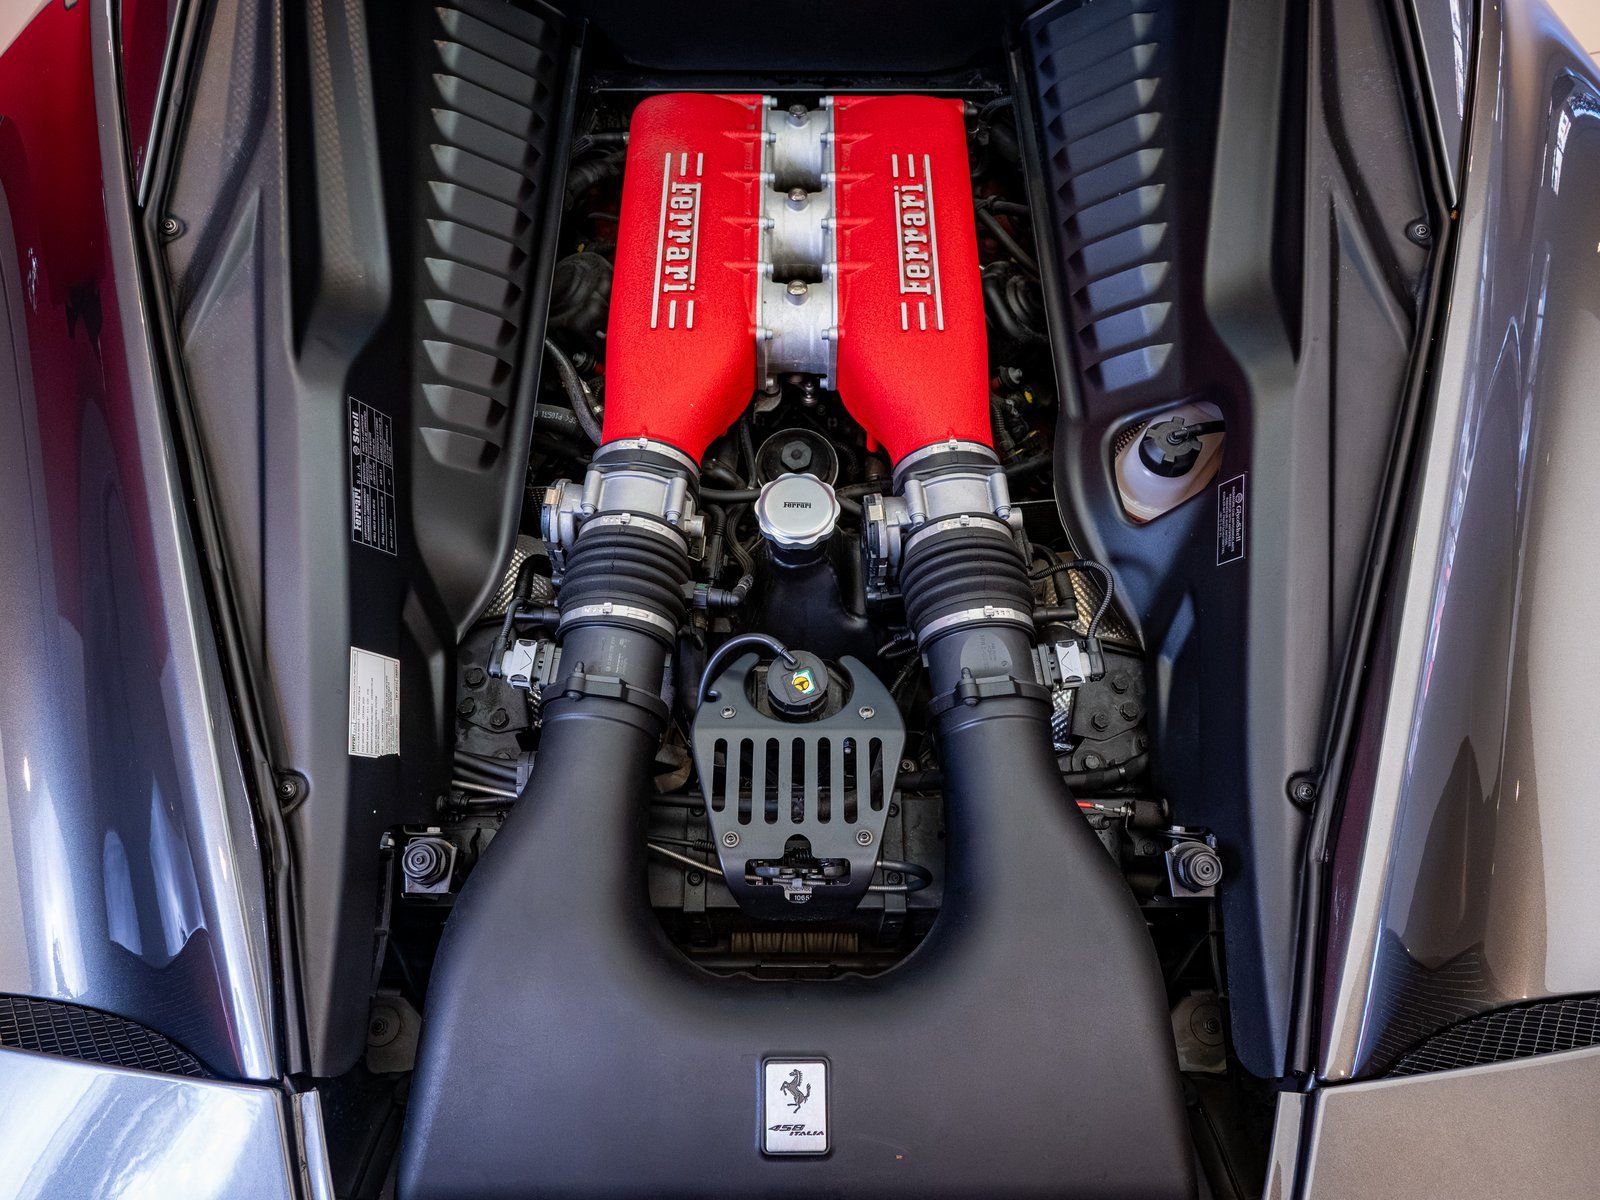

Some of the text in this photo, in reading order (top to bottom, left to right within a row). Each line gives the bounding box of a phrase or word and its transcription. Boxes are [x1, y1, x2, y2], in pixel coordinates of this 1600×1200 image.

[663, 181, 702, 293] Ferrari
[893, 183, 932, 296] Ferrari
[352, 411, 360, 444] Shell
[352, 487, 362, 531] Ferrari
[783, 501, 812, 509] Ferrari
[768, 1124, 806, 1132] 458
